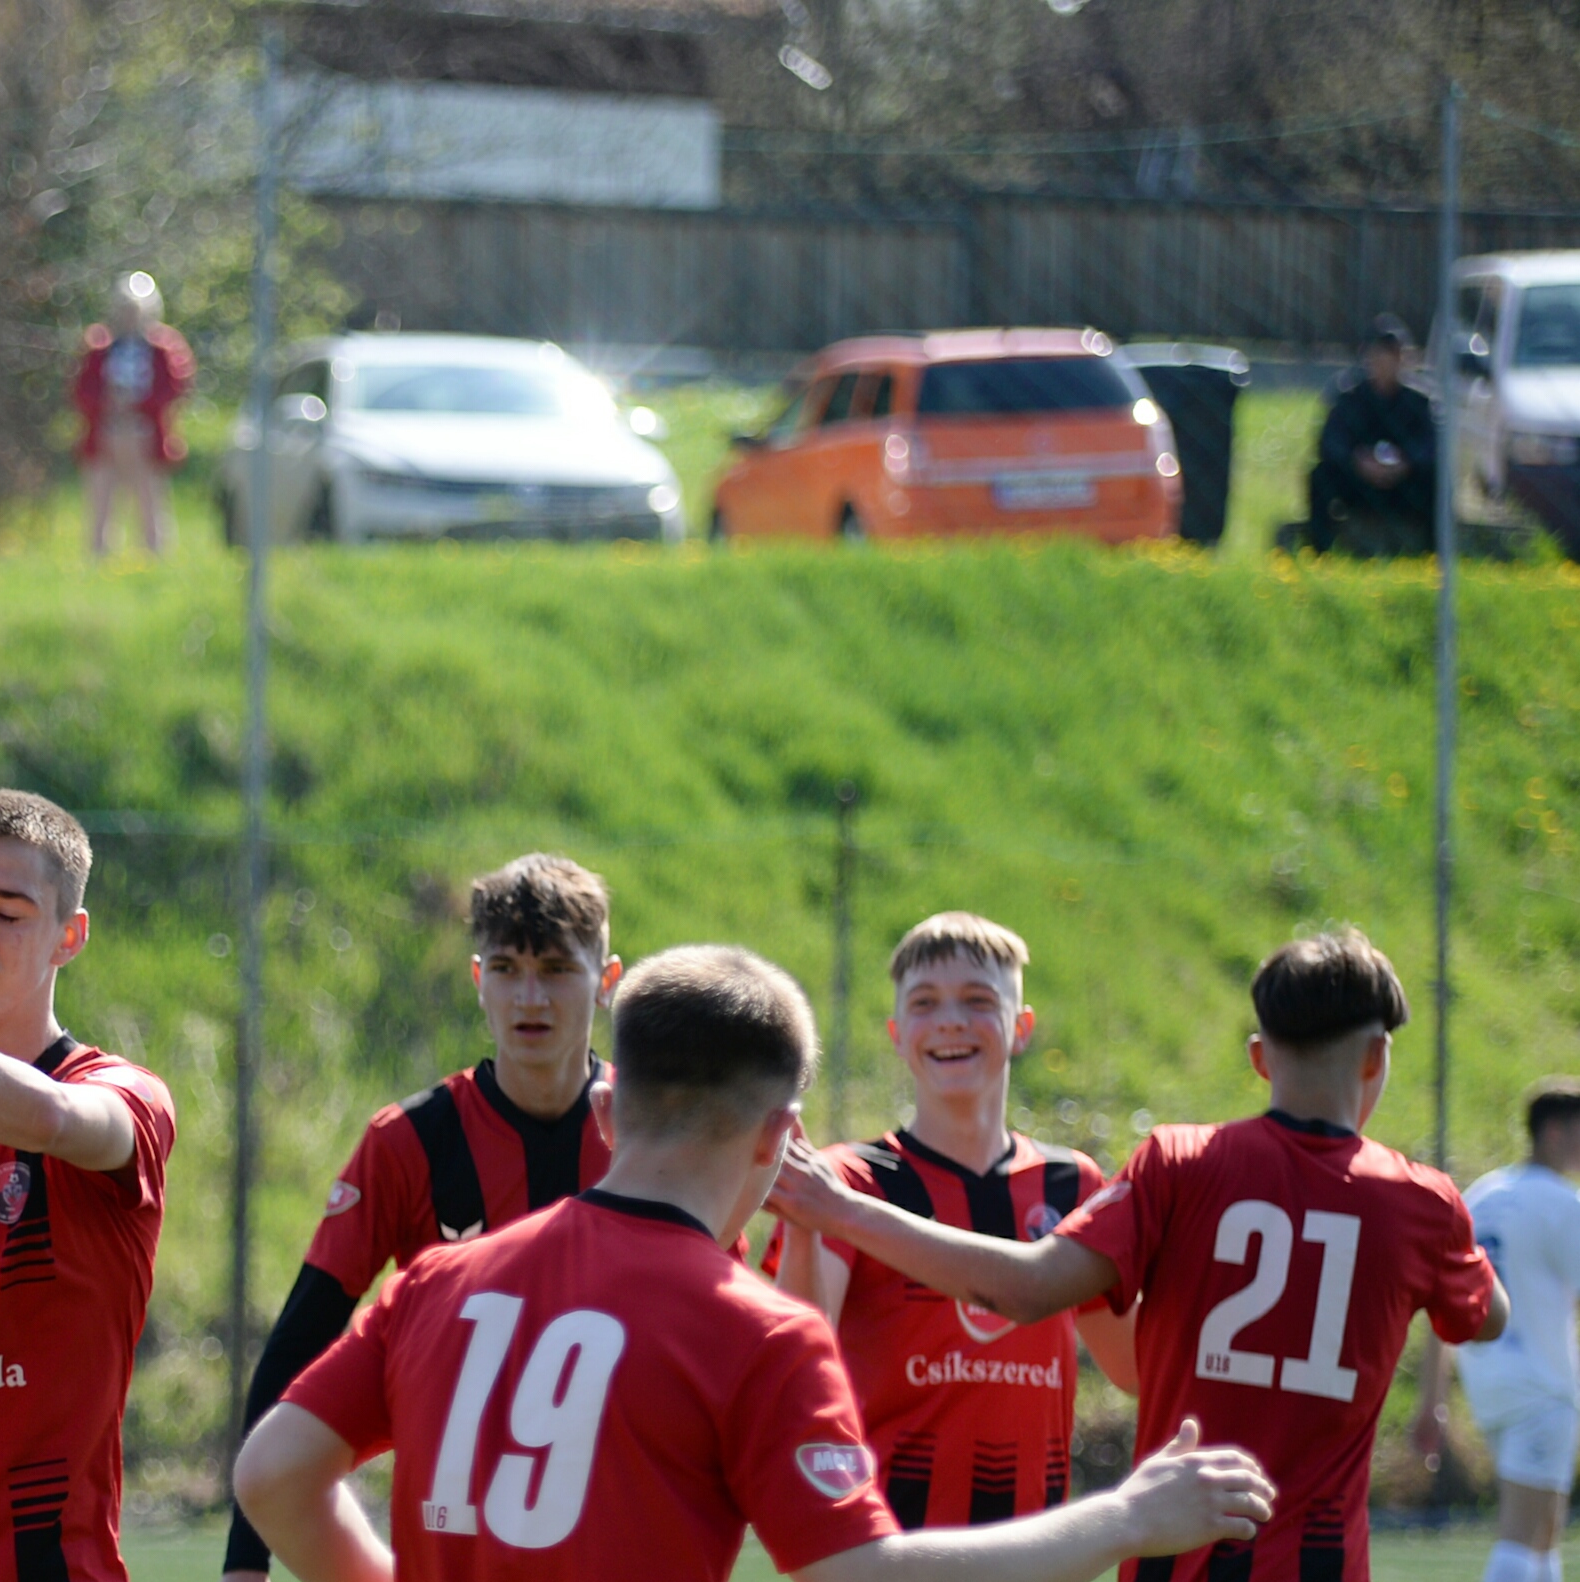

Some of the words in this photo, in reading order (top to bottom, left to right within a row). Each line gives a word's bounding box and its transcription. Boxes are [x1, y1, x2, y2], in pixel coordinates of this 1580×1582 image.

[1196, 1199, 1361, 1403] 21
[422, 1292, 625, 1548] 19
[905, 1350, 1063, 1389] Csíkszered
[813, 1451, 857, 1472] MOL
